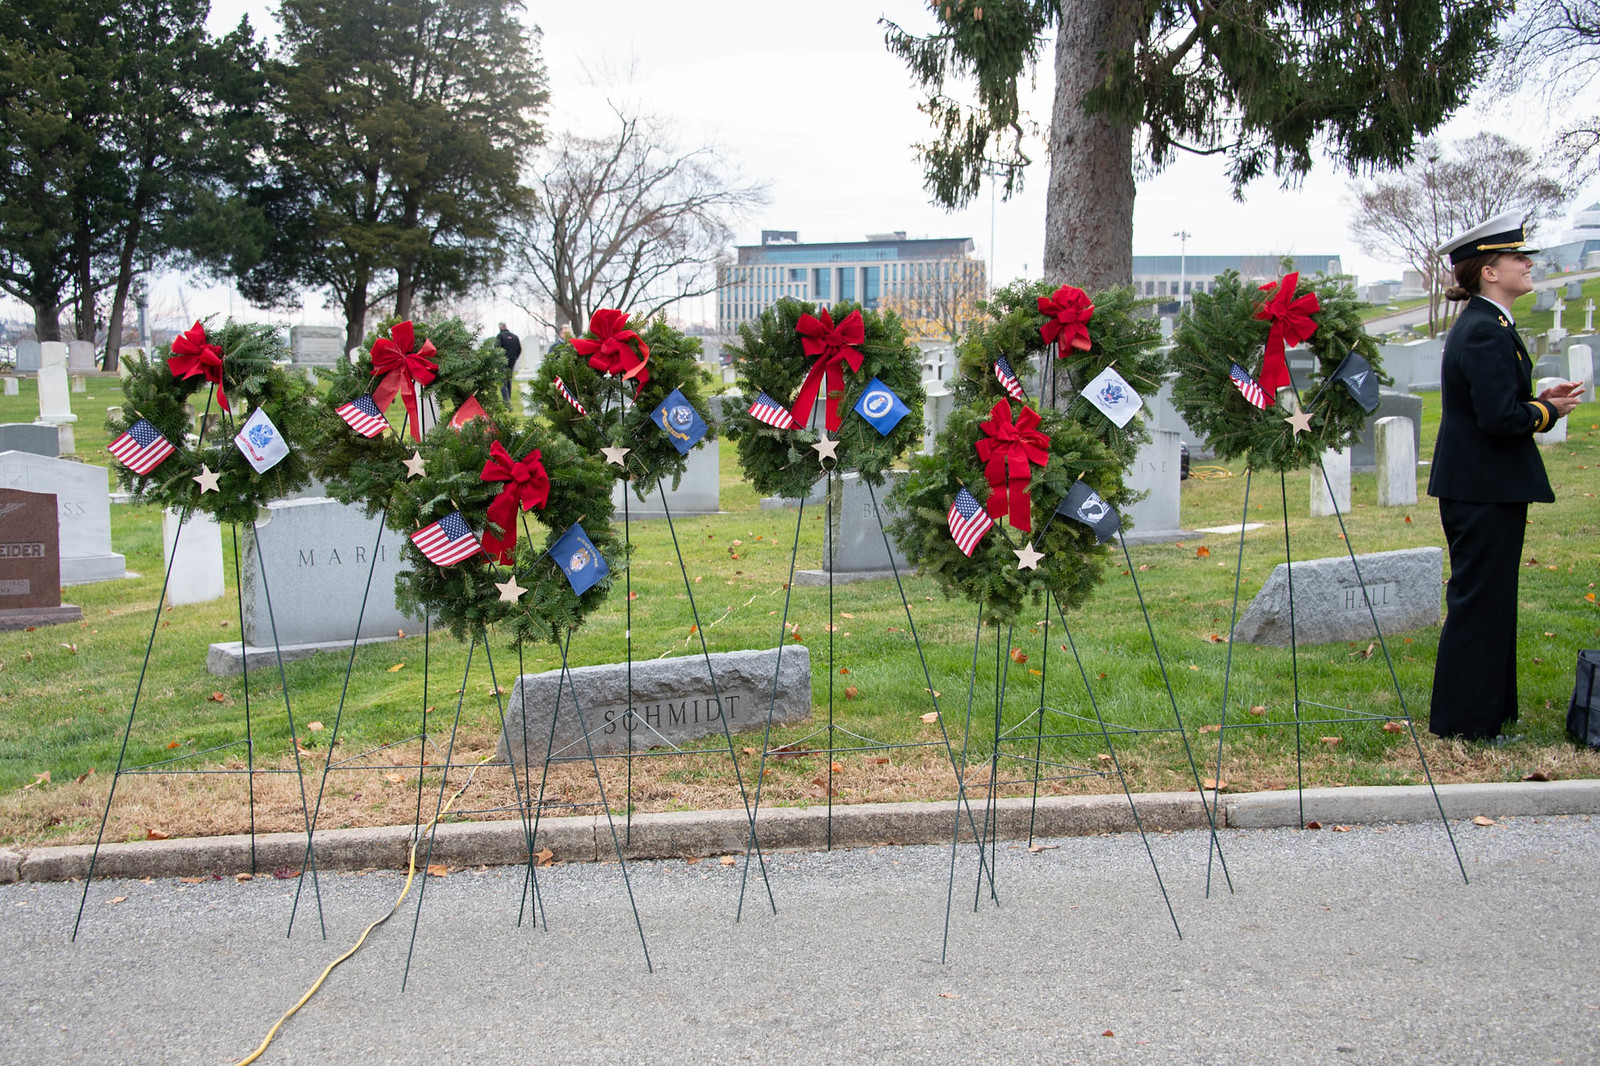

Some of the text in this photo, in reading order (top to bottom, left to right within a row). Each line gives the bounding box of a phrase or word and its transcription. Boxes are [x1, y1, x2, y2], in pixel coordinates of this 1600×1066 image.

[1140, 460, 1167, 473] INE
[63, 502, 86, 517] SS
[298, 544, 387, 568] MARI
[1345, 586, 1391, 609] HALL
[603, 695, 740, 735] SCHMIDT
